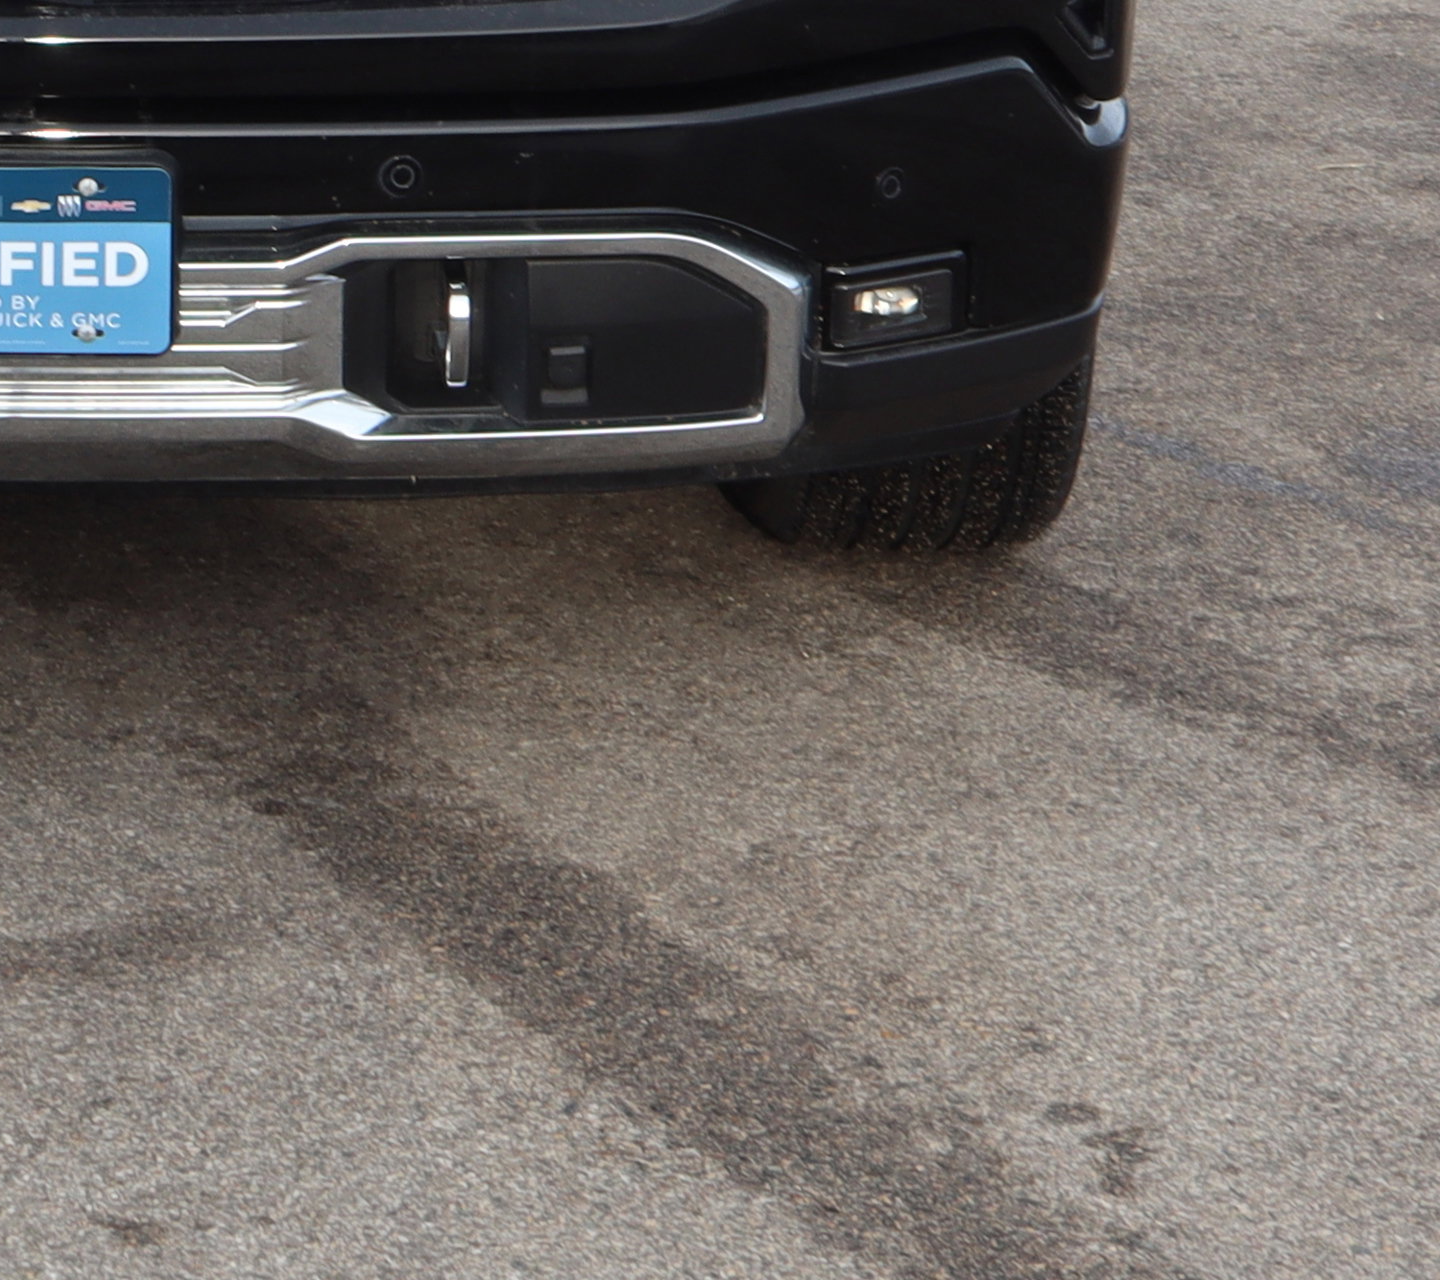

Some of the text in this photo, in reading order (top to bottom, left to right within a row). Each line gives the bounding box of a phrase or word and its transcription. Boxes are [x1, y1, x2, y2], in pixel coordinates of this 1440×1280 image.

[84, 199, 137, 213] GMC
[11, 295, 40, 311] BY
[49, 312, 64, 329] &
[71, 312, 121, 329] GMC
